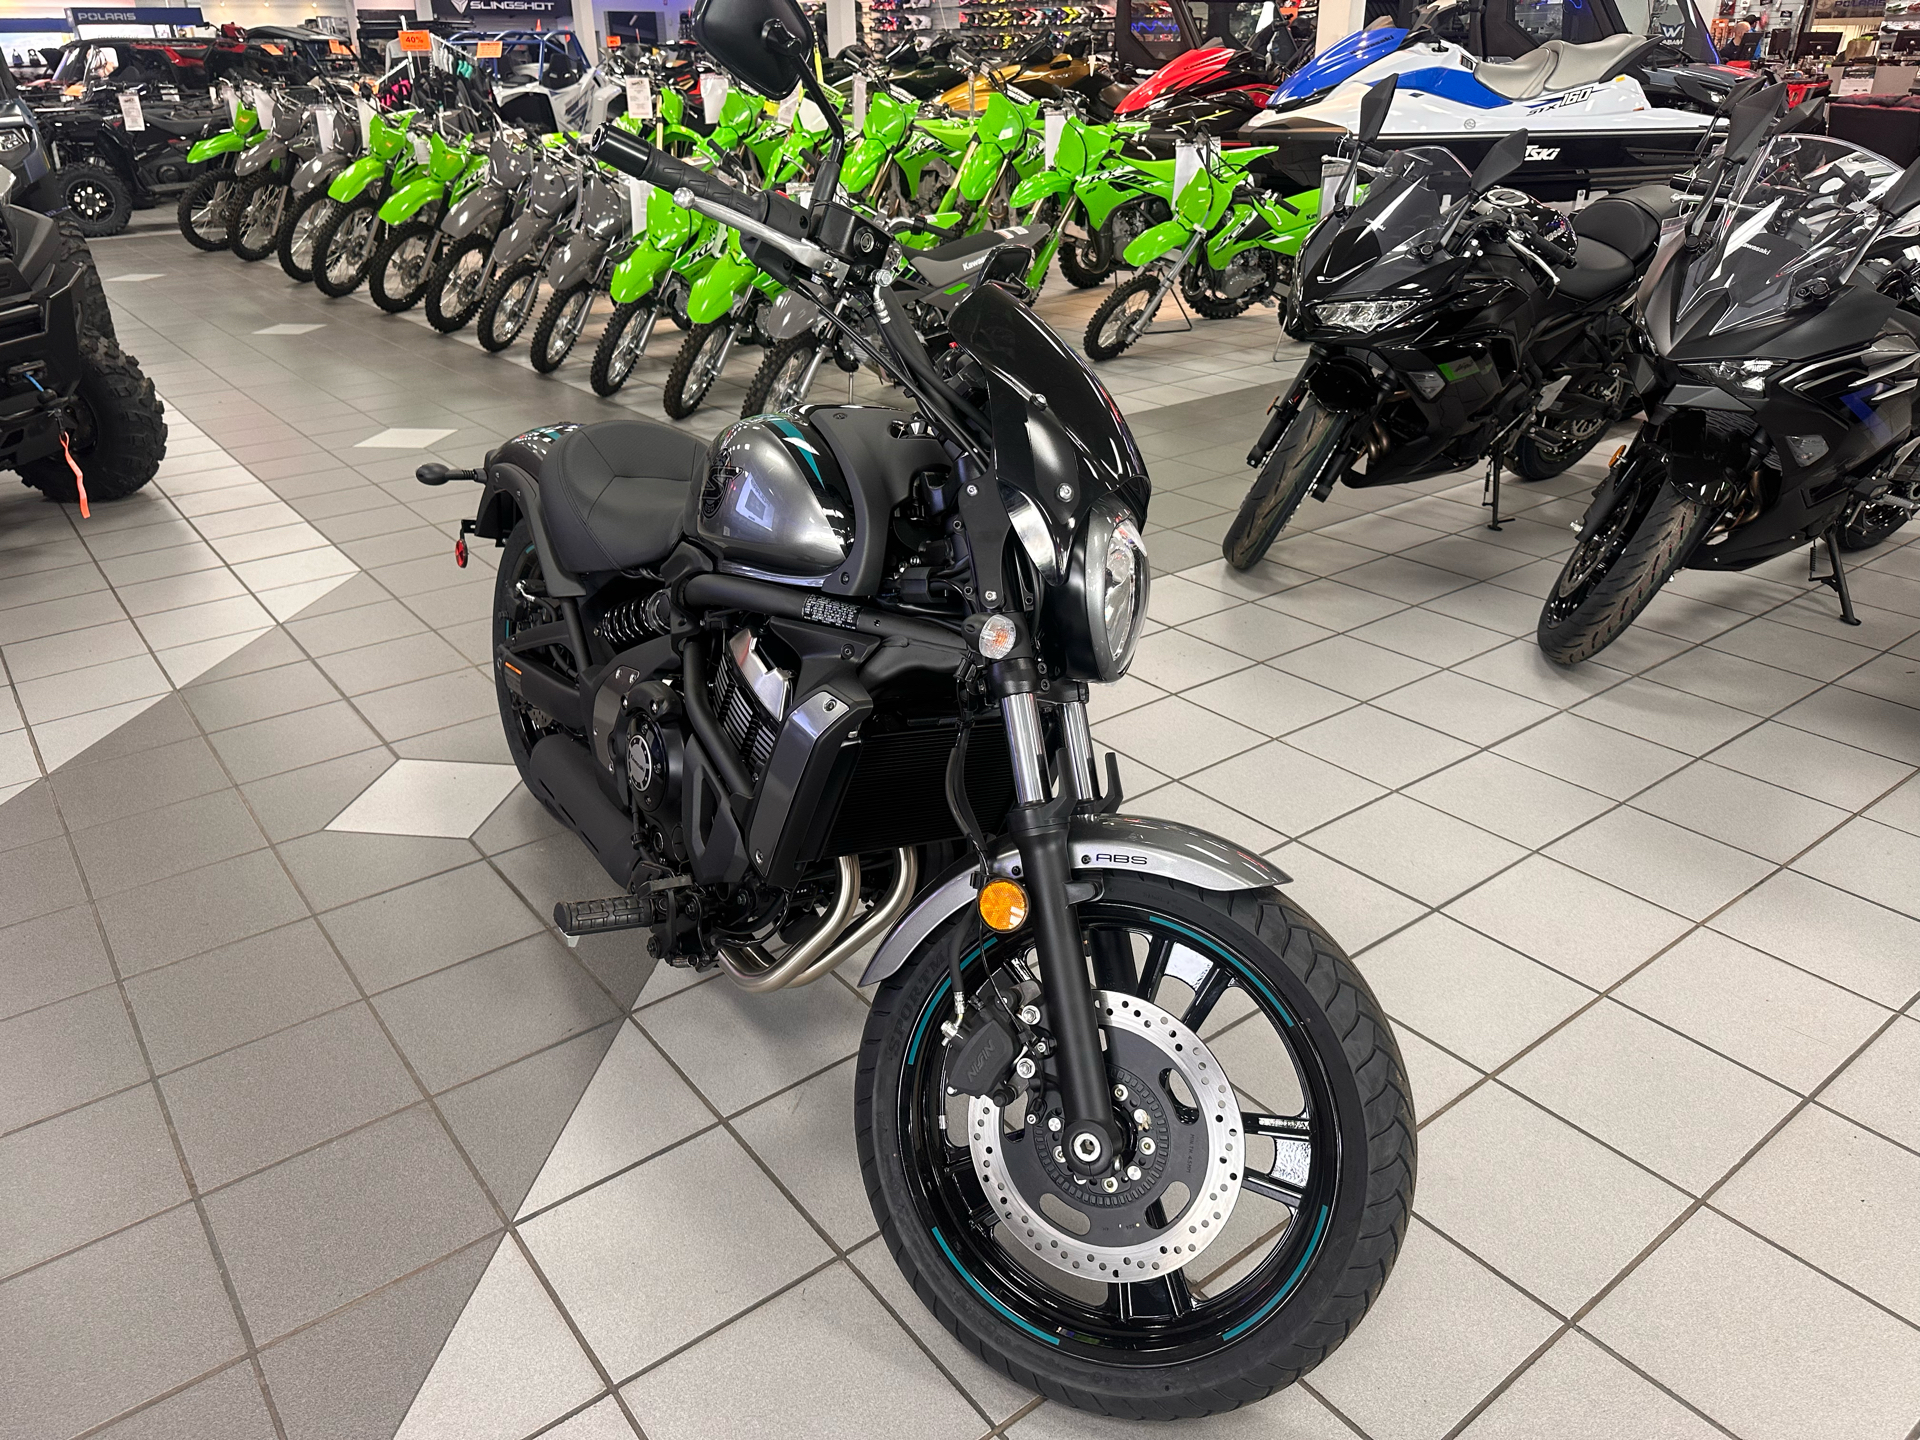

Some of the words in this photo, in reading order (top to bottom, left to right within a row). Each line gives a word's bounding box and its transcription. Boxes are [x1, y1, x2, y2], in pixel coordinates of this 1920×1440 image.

[470, 1, 555, 11] SLINGSHOT
[77, 12, 137, 21] POLARIS
[405, 36, 424, 44] 40%
[1526, 103, 1560, 117] STX
[1558, 86, 1595, 108] 160
[1741, 242, 1772, 256] awasaki
[1096, 853, 1148, 865] ABS
